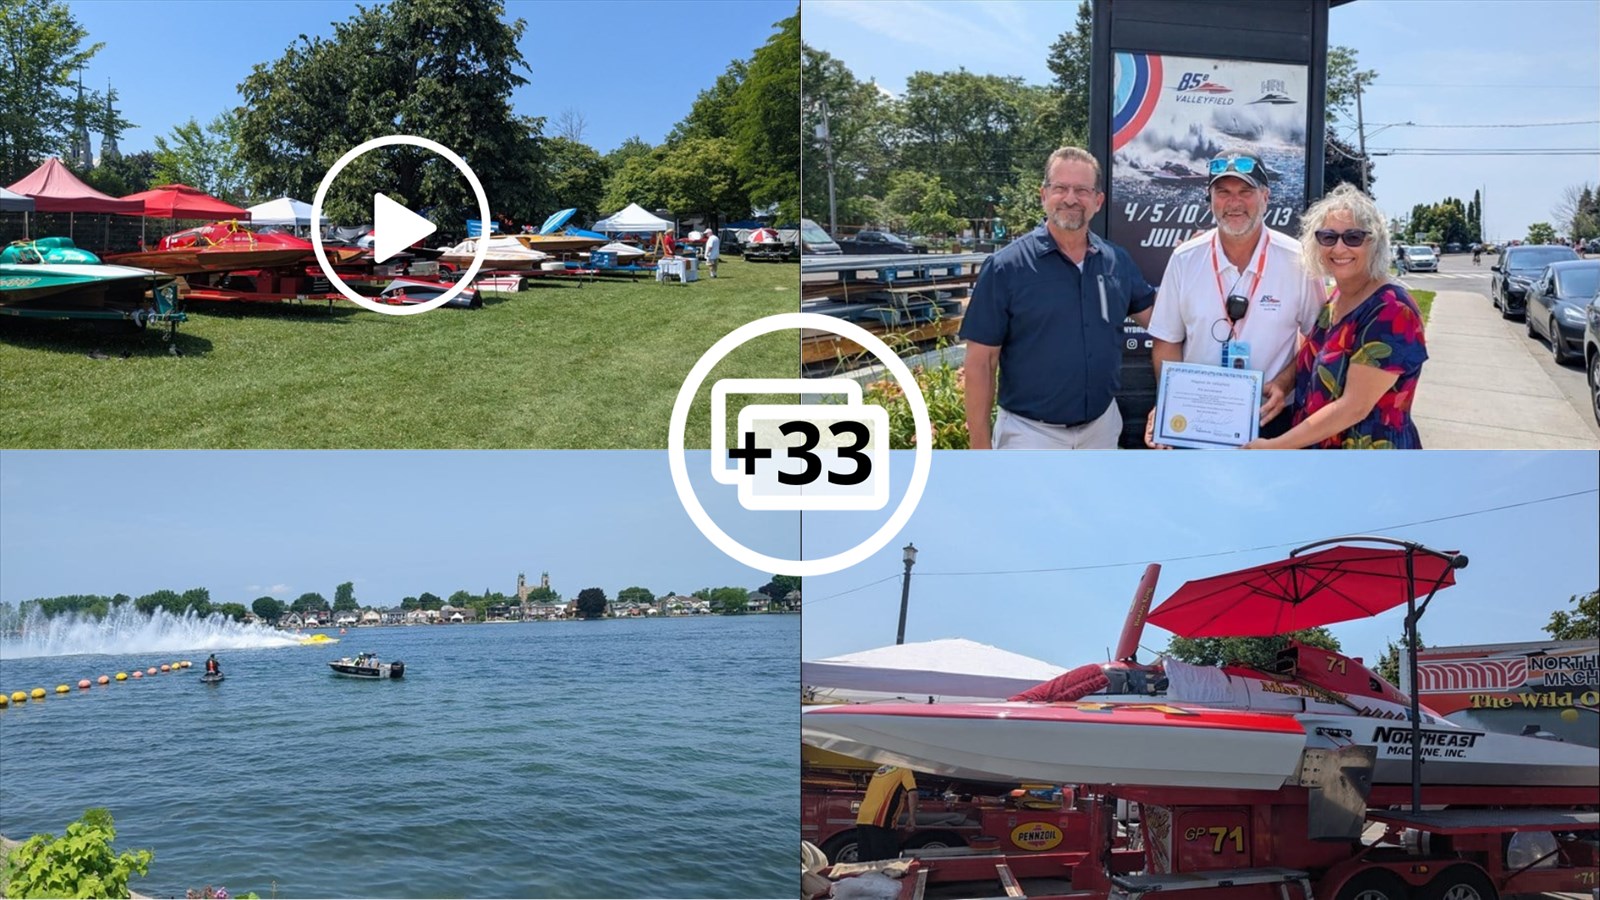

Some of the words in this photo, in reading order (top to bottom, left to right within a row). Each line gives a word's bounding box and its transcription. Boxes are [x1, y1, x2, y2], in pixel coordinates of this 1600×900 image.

[1175, 95, 1235, 106] VALLEYFIELD
[1326, 656, 1348, 675] 71
[1530, 655, 1599, 671] NORTH
[1469, 693, 1513, 709] The
[1518, 691, 1574, 709] Wild
[1444, 749, 1467, 758] INC.
[1017, 829, 1057, 841] PENNZOIL
[1184, 826, 1206, 841] GP
[1209, 826, 1244, 852] 71
